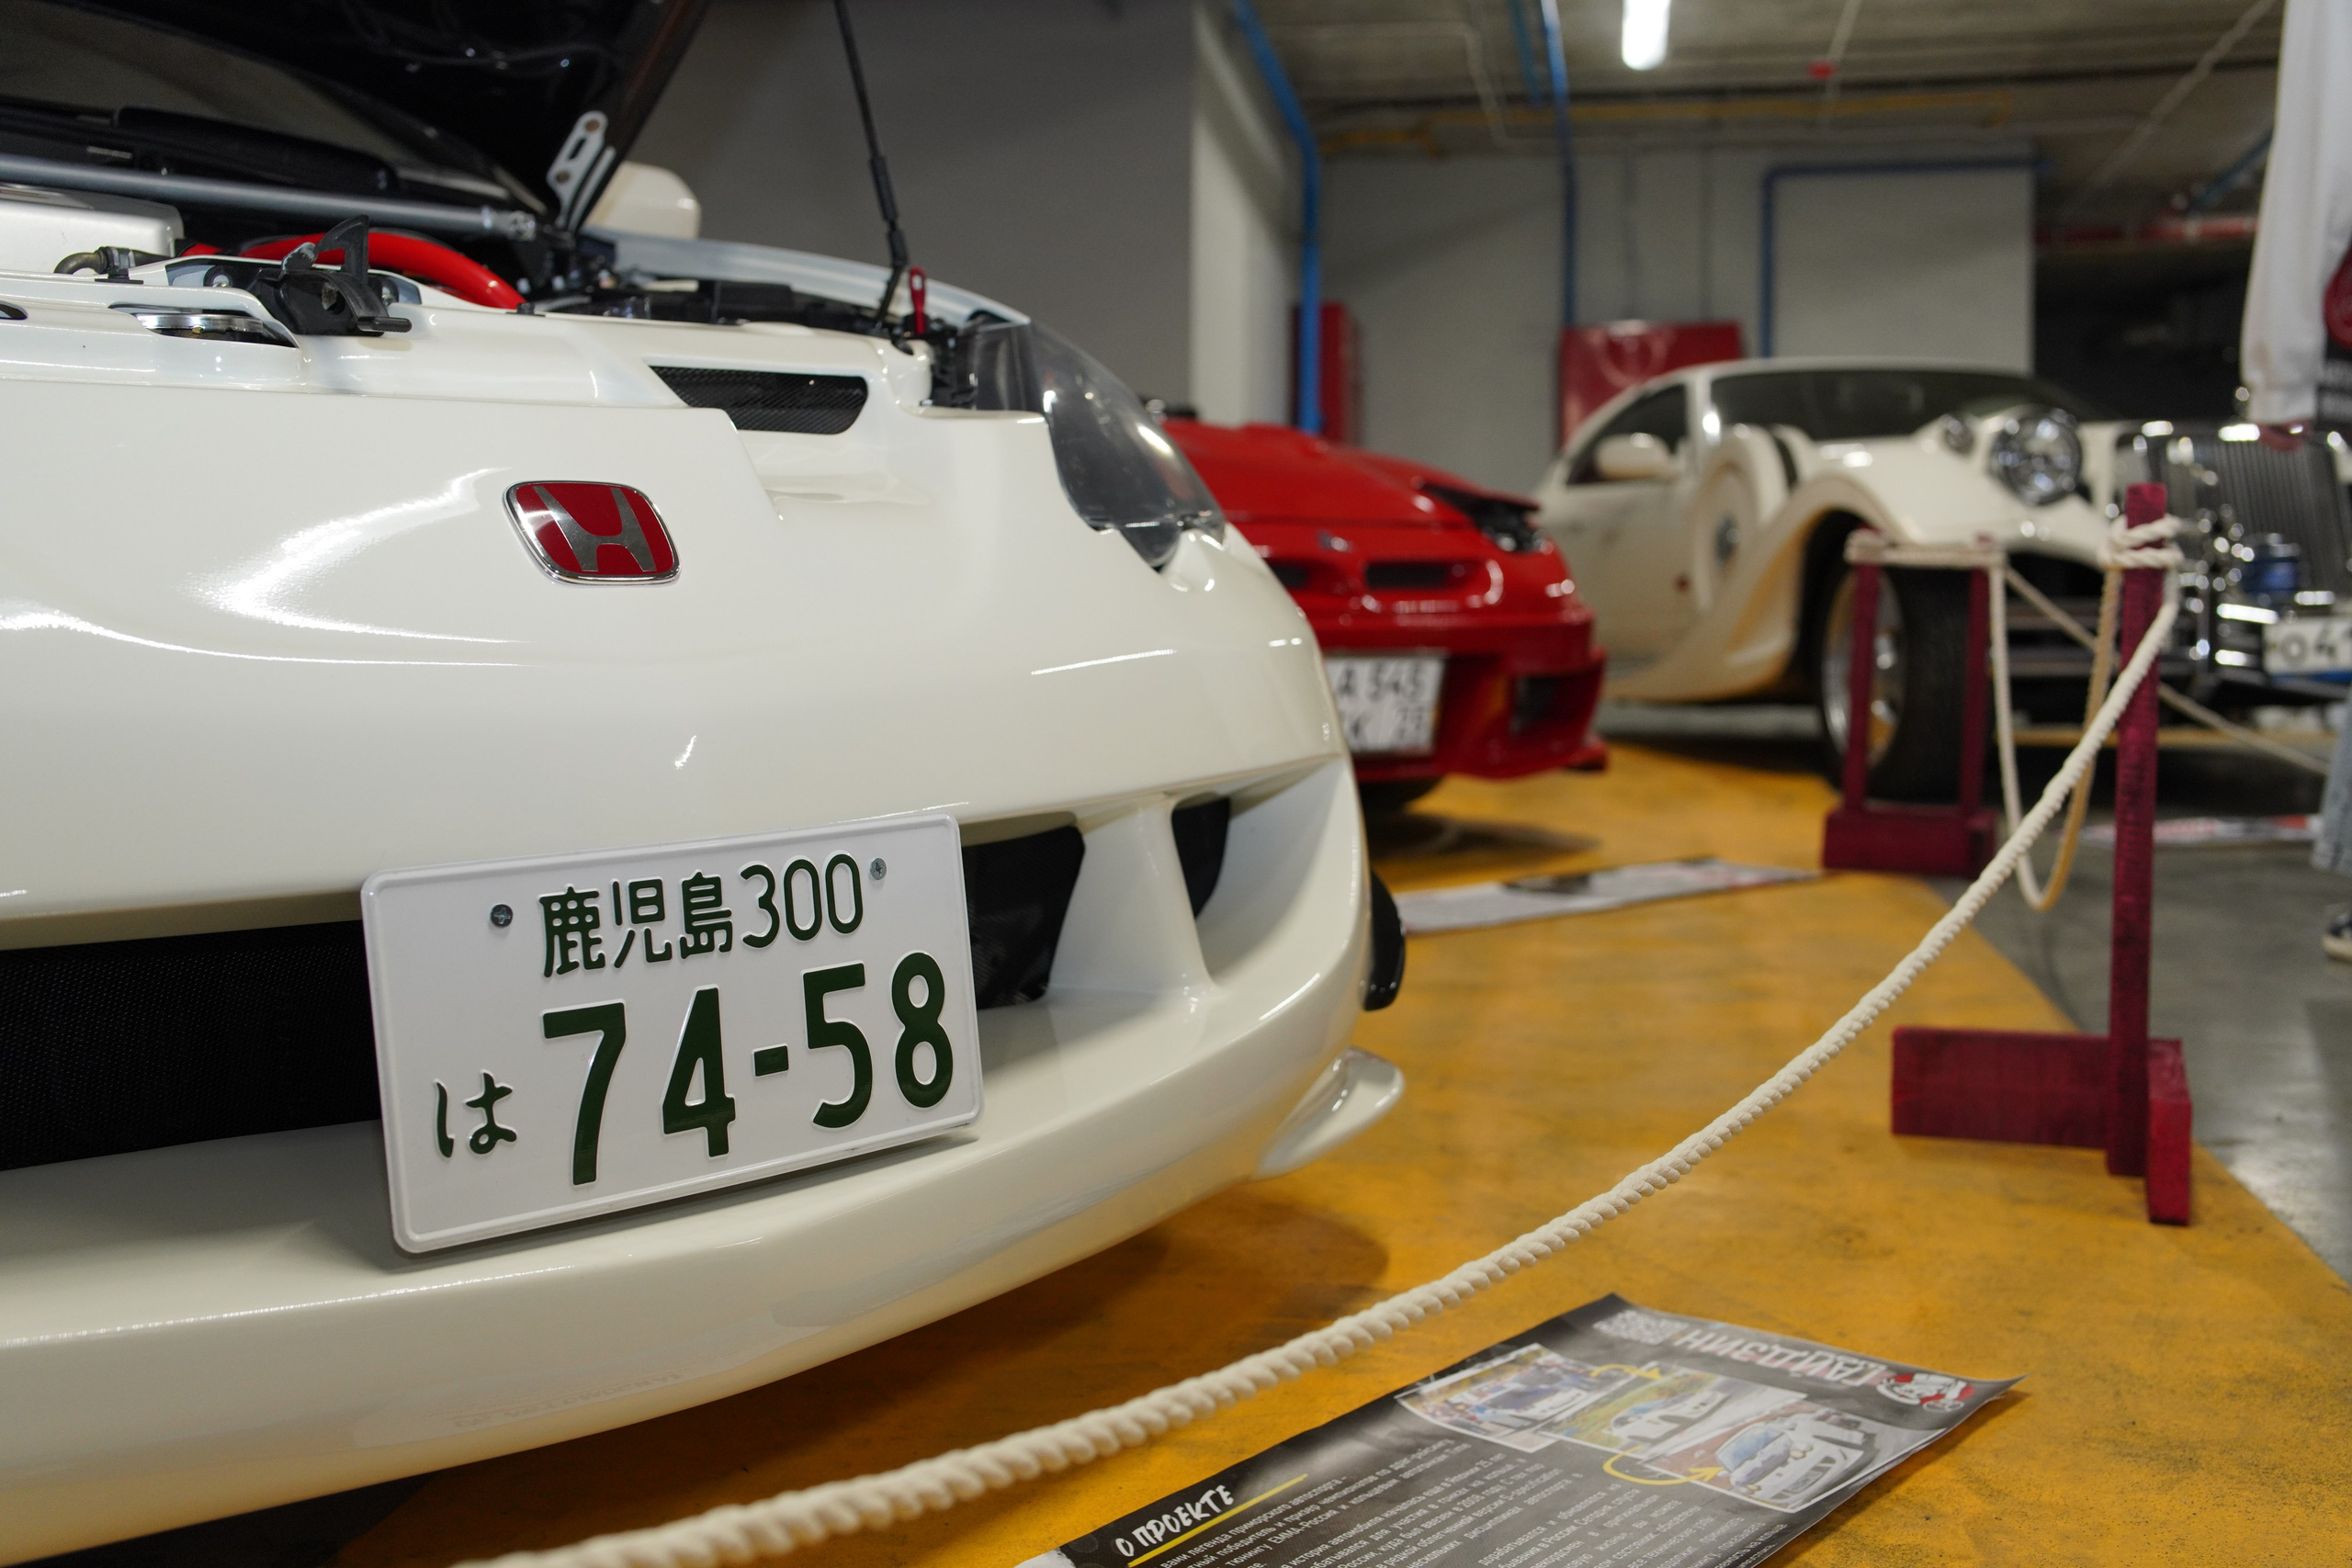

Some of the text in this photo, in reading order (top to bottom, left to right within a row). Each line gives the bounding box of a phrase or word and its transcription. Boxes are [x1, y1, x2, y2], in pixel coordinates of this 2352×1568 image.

[435, 952, 953, 1186] は 74-58
[1115, 1485, 1235, 1557] О ПРОЕКТЕ
[1187, 1532, 1233, 1556] легенда
[1227, 1503, 1293, 1536] приморского
[1287, 1478, 1343, 1506] автоспорта
[1216, 1526, 1277, 1556] победитель
[1283, 1503, 1321, 1523] призер
[1288, 1542, 1332, 1566] история
[1328, 1515, 1385, 1545] автомобиля
[1380, 1495, 1427, 1518] началась
[1368, 1528, 1392, 1541] для
[1389, 1507, 1430, 1530] участия
[1376, 1537, 1405, 1551] куда
[1398, 1526, 1425, 1540] был
[1382, 1543, 1421, 1567] редкой
[1416, 1515, 1476, 1548] облегченной
[1471, 1498, 1507, 1517] версии
[1477, 1525, 1547, 1566] дорабатывался
[1224, 1542, 1273, 1566] тюнингу
